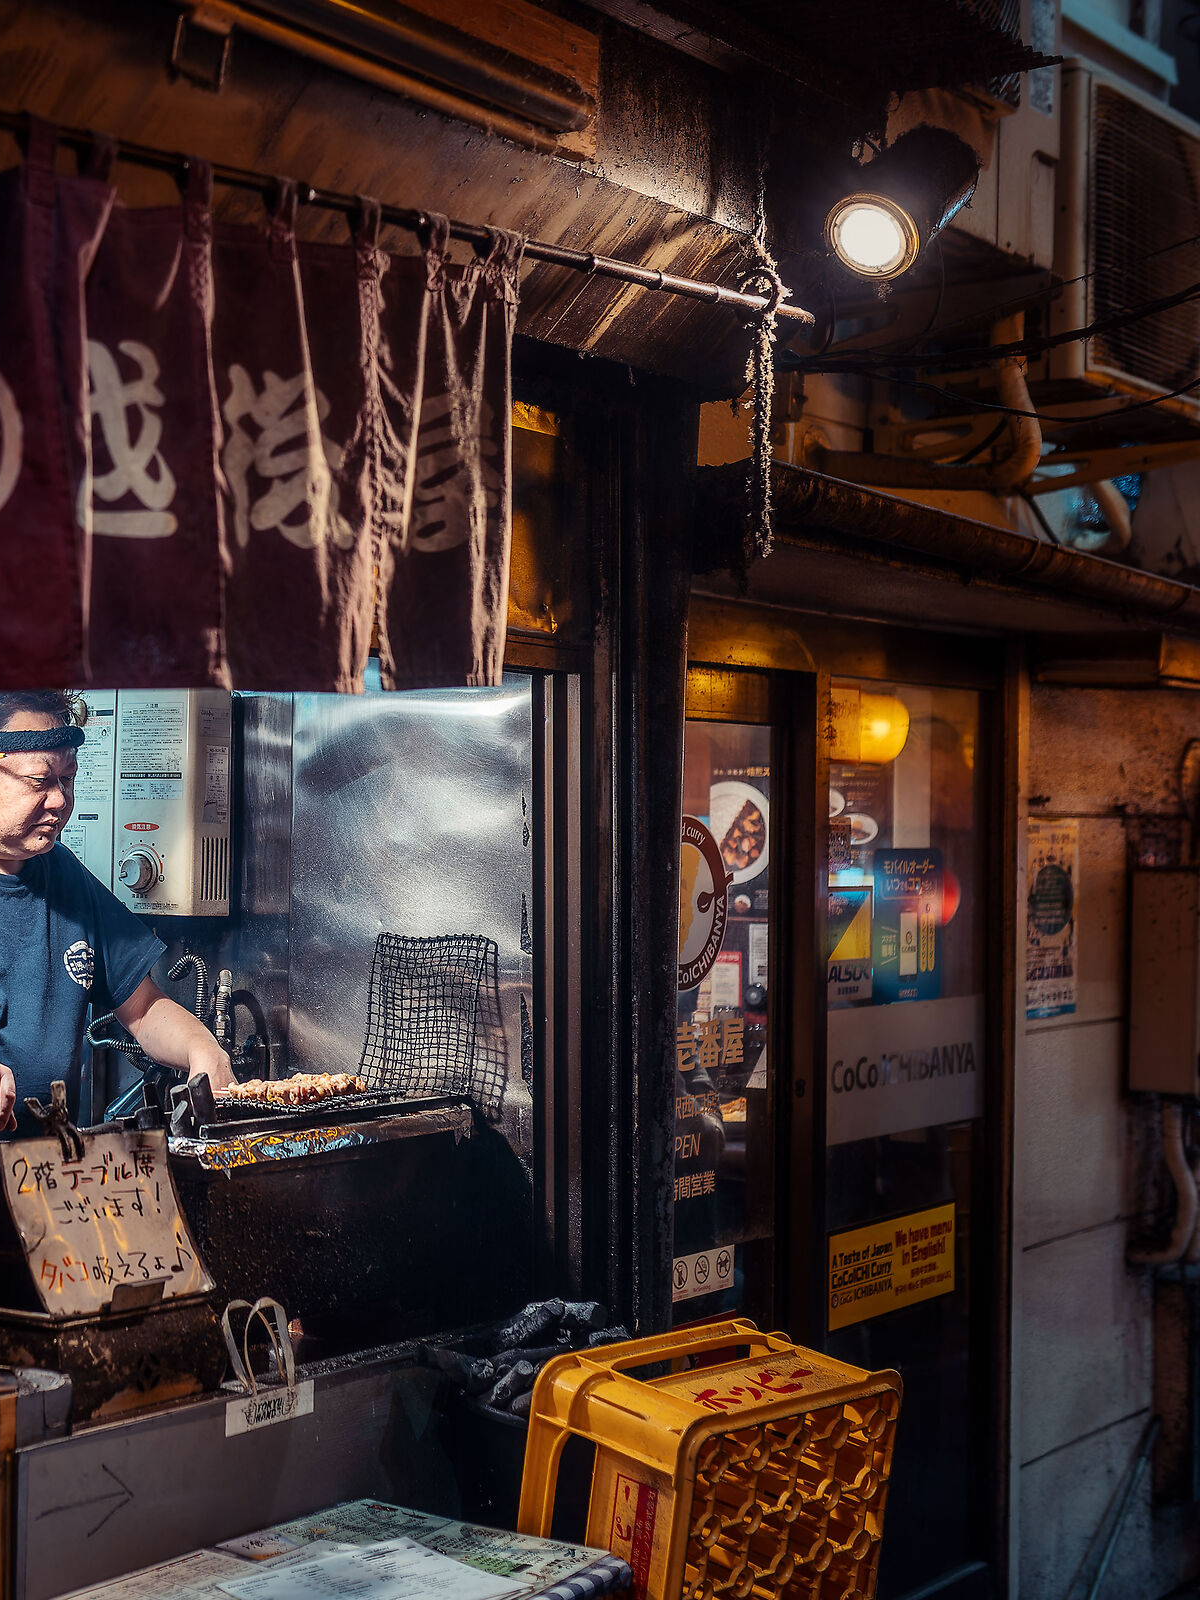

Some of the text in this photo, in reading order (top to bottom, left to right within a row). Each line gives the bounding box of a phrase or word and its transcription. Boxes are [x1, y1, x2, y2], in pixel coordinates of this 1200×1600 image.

[686, 825, 706, 845] curry
[884, 858, 935, 875] モバイルオーダー
[678, 895, 726, 986] CoICHIBANYA
[828, 963, 869, 983] ALSOK
[677, 1017, 744, 1071] 壱番屋
[675, 1132, 701, 1159] PEN
[13, 1144, 155, 1194] 2階テーブル席
[895, 1219, 953, 1248] We have menu
[832, 1242, 893, 1268] A Taste of Japan
[902, 1236, 946, 1265] in English!
[871, 1260, 893, 1277] Curry
[693, 1367, 815, 1411] ホッピー
